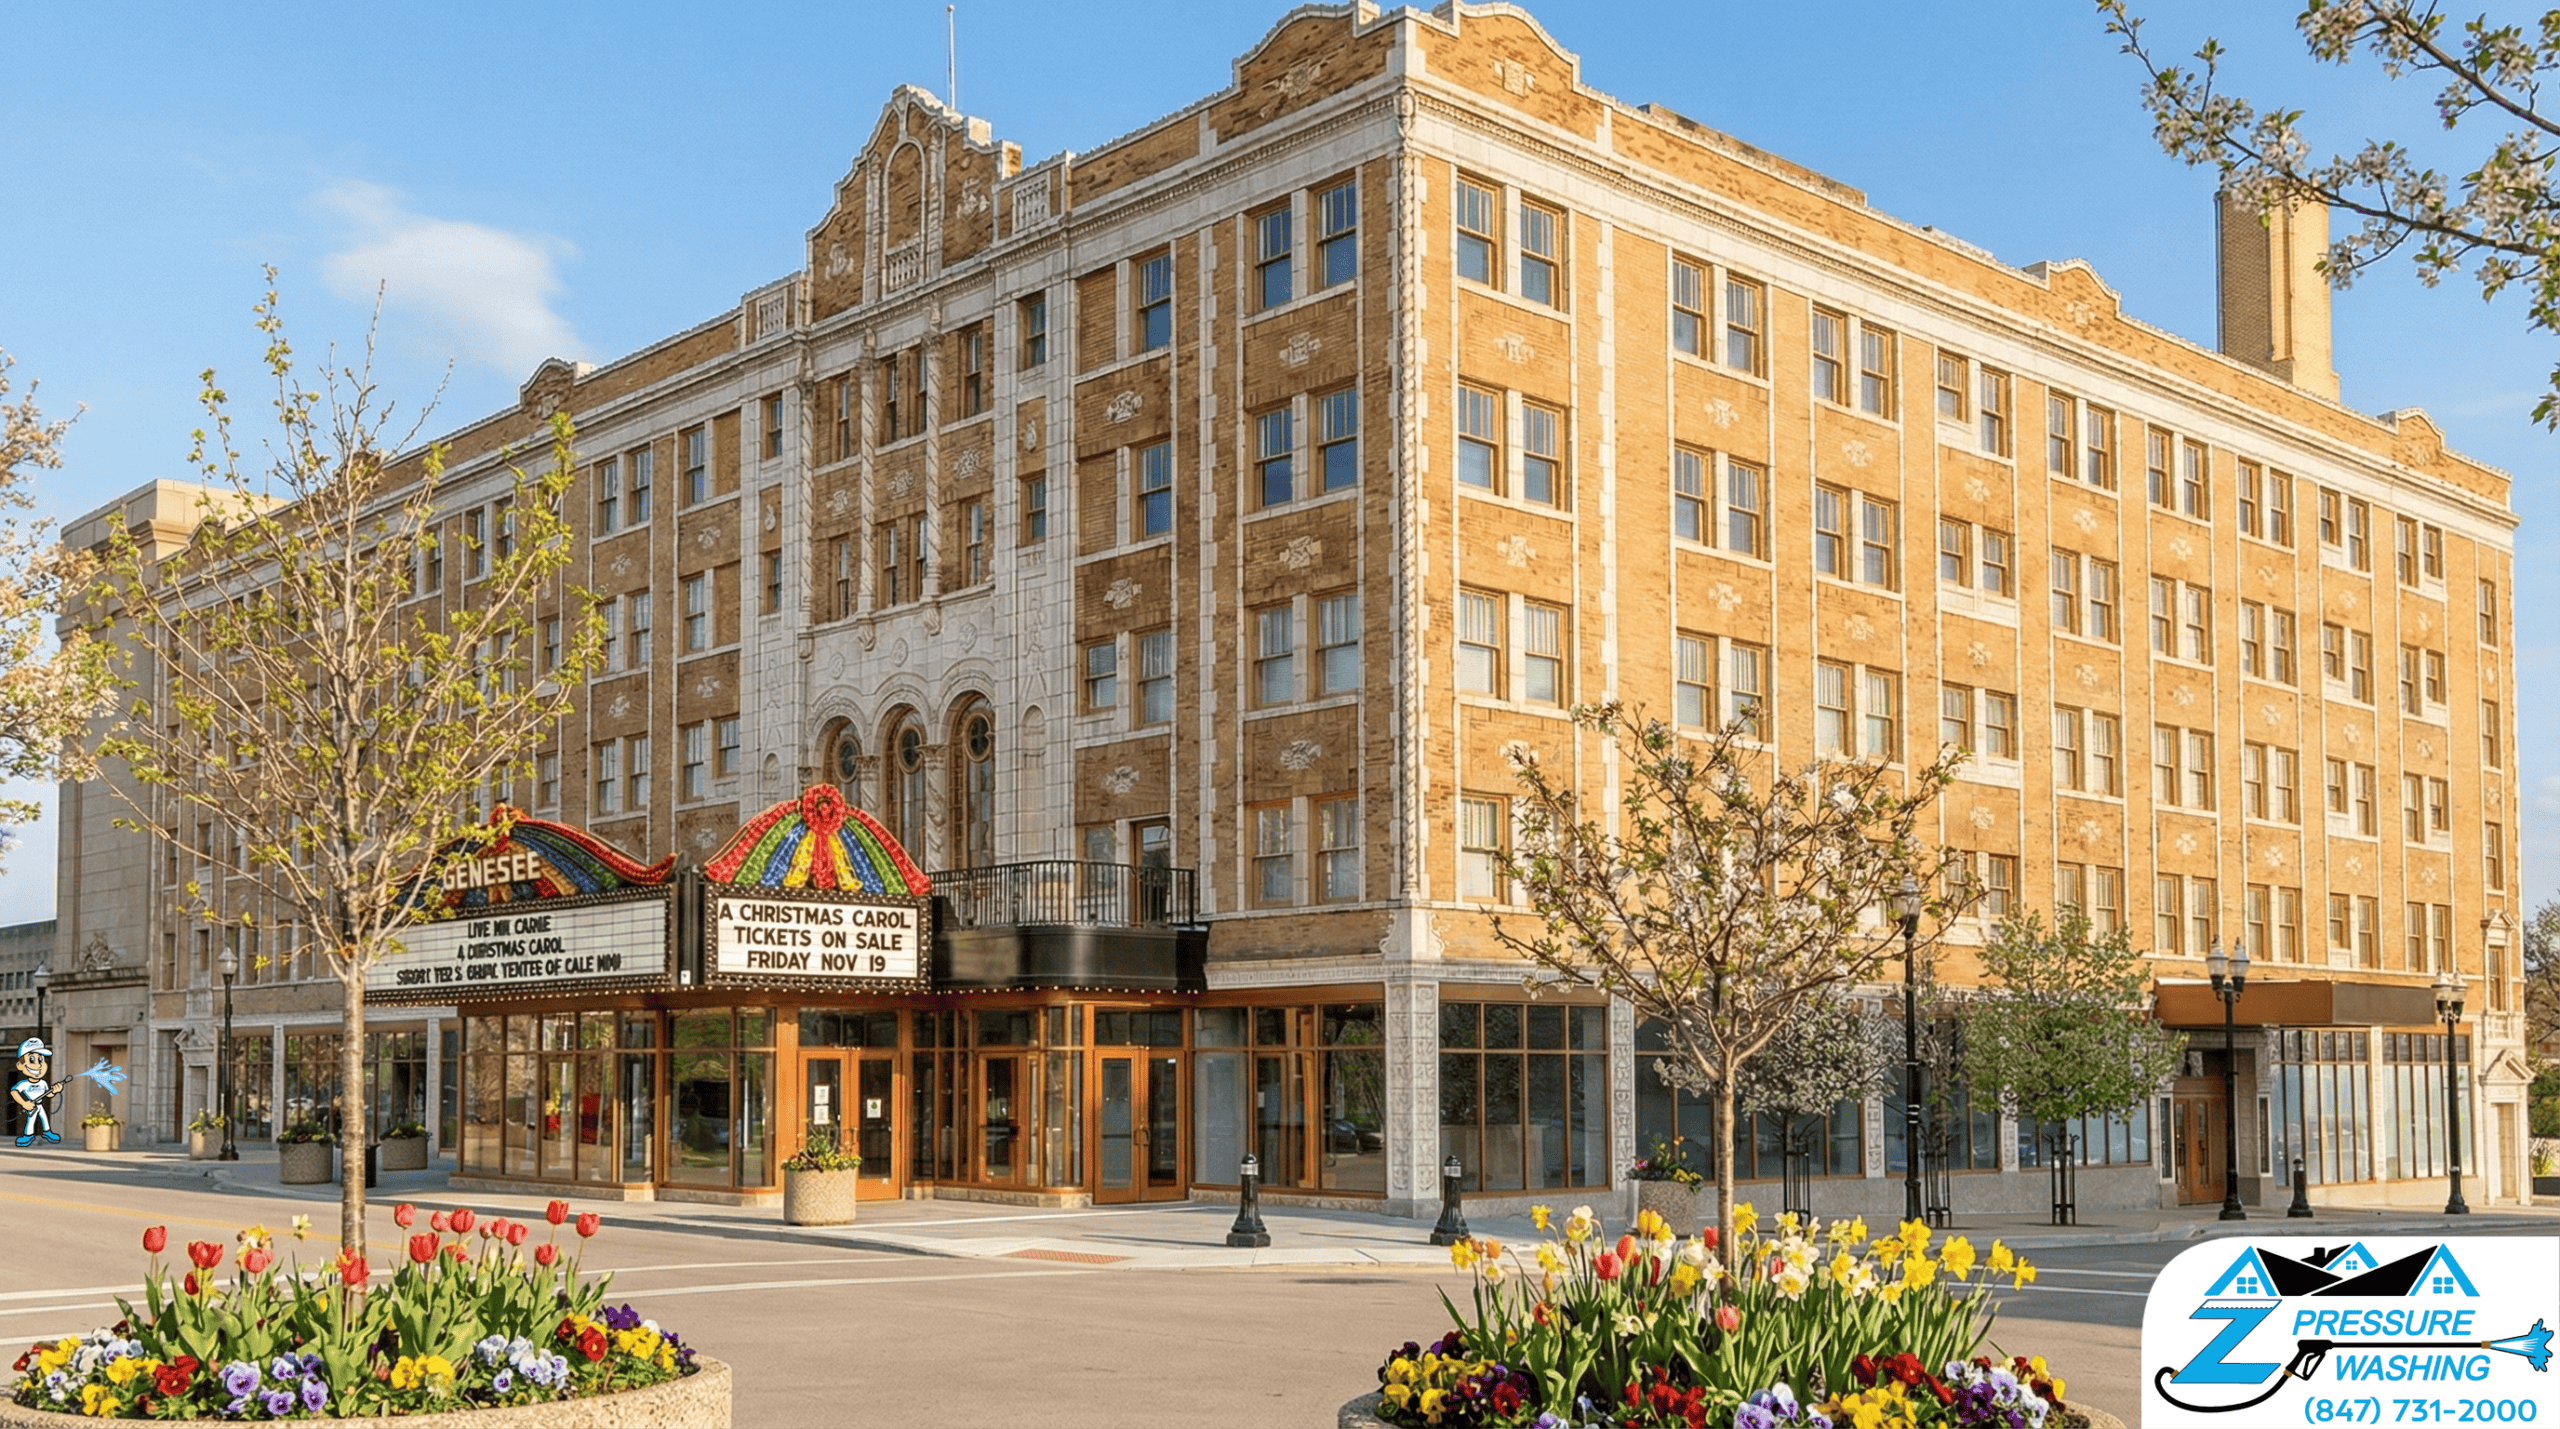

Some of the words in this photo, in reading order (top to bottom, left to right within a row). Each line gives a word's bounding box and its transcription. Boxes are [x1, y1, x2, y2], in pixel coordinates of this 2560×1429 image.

[443, 851, 541, 890] GENESEE
[719, 902, 733, 920] A
[739, 904, 843, 926] CHRISTMAS
[852, 909, 911, 929] CAROL
[734, 926, 812, 947] TICKETS
[821, 931, 846, 949] ON
[855, 932, 902, 951] SALE
[545, 958, 562, 976] OF
[747, 950, 811, 970] FRIDAY
[821, 953, 858, 972] NOV
[869, 955, 886, 972] 19
